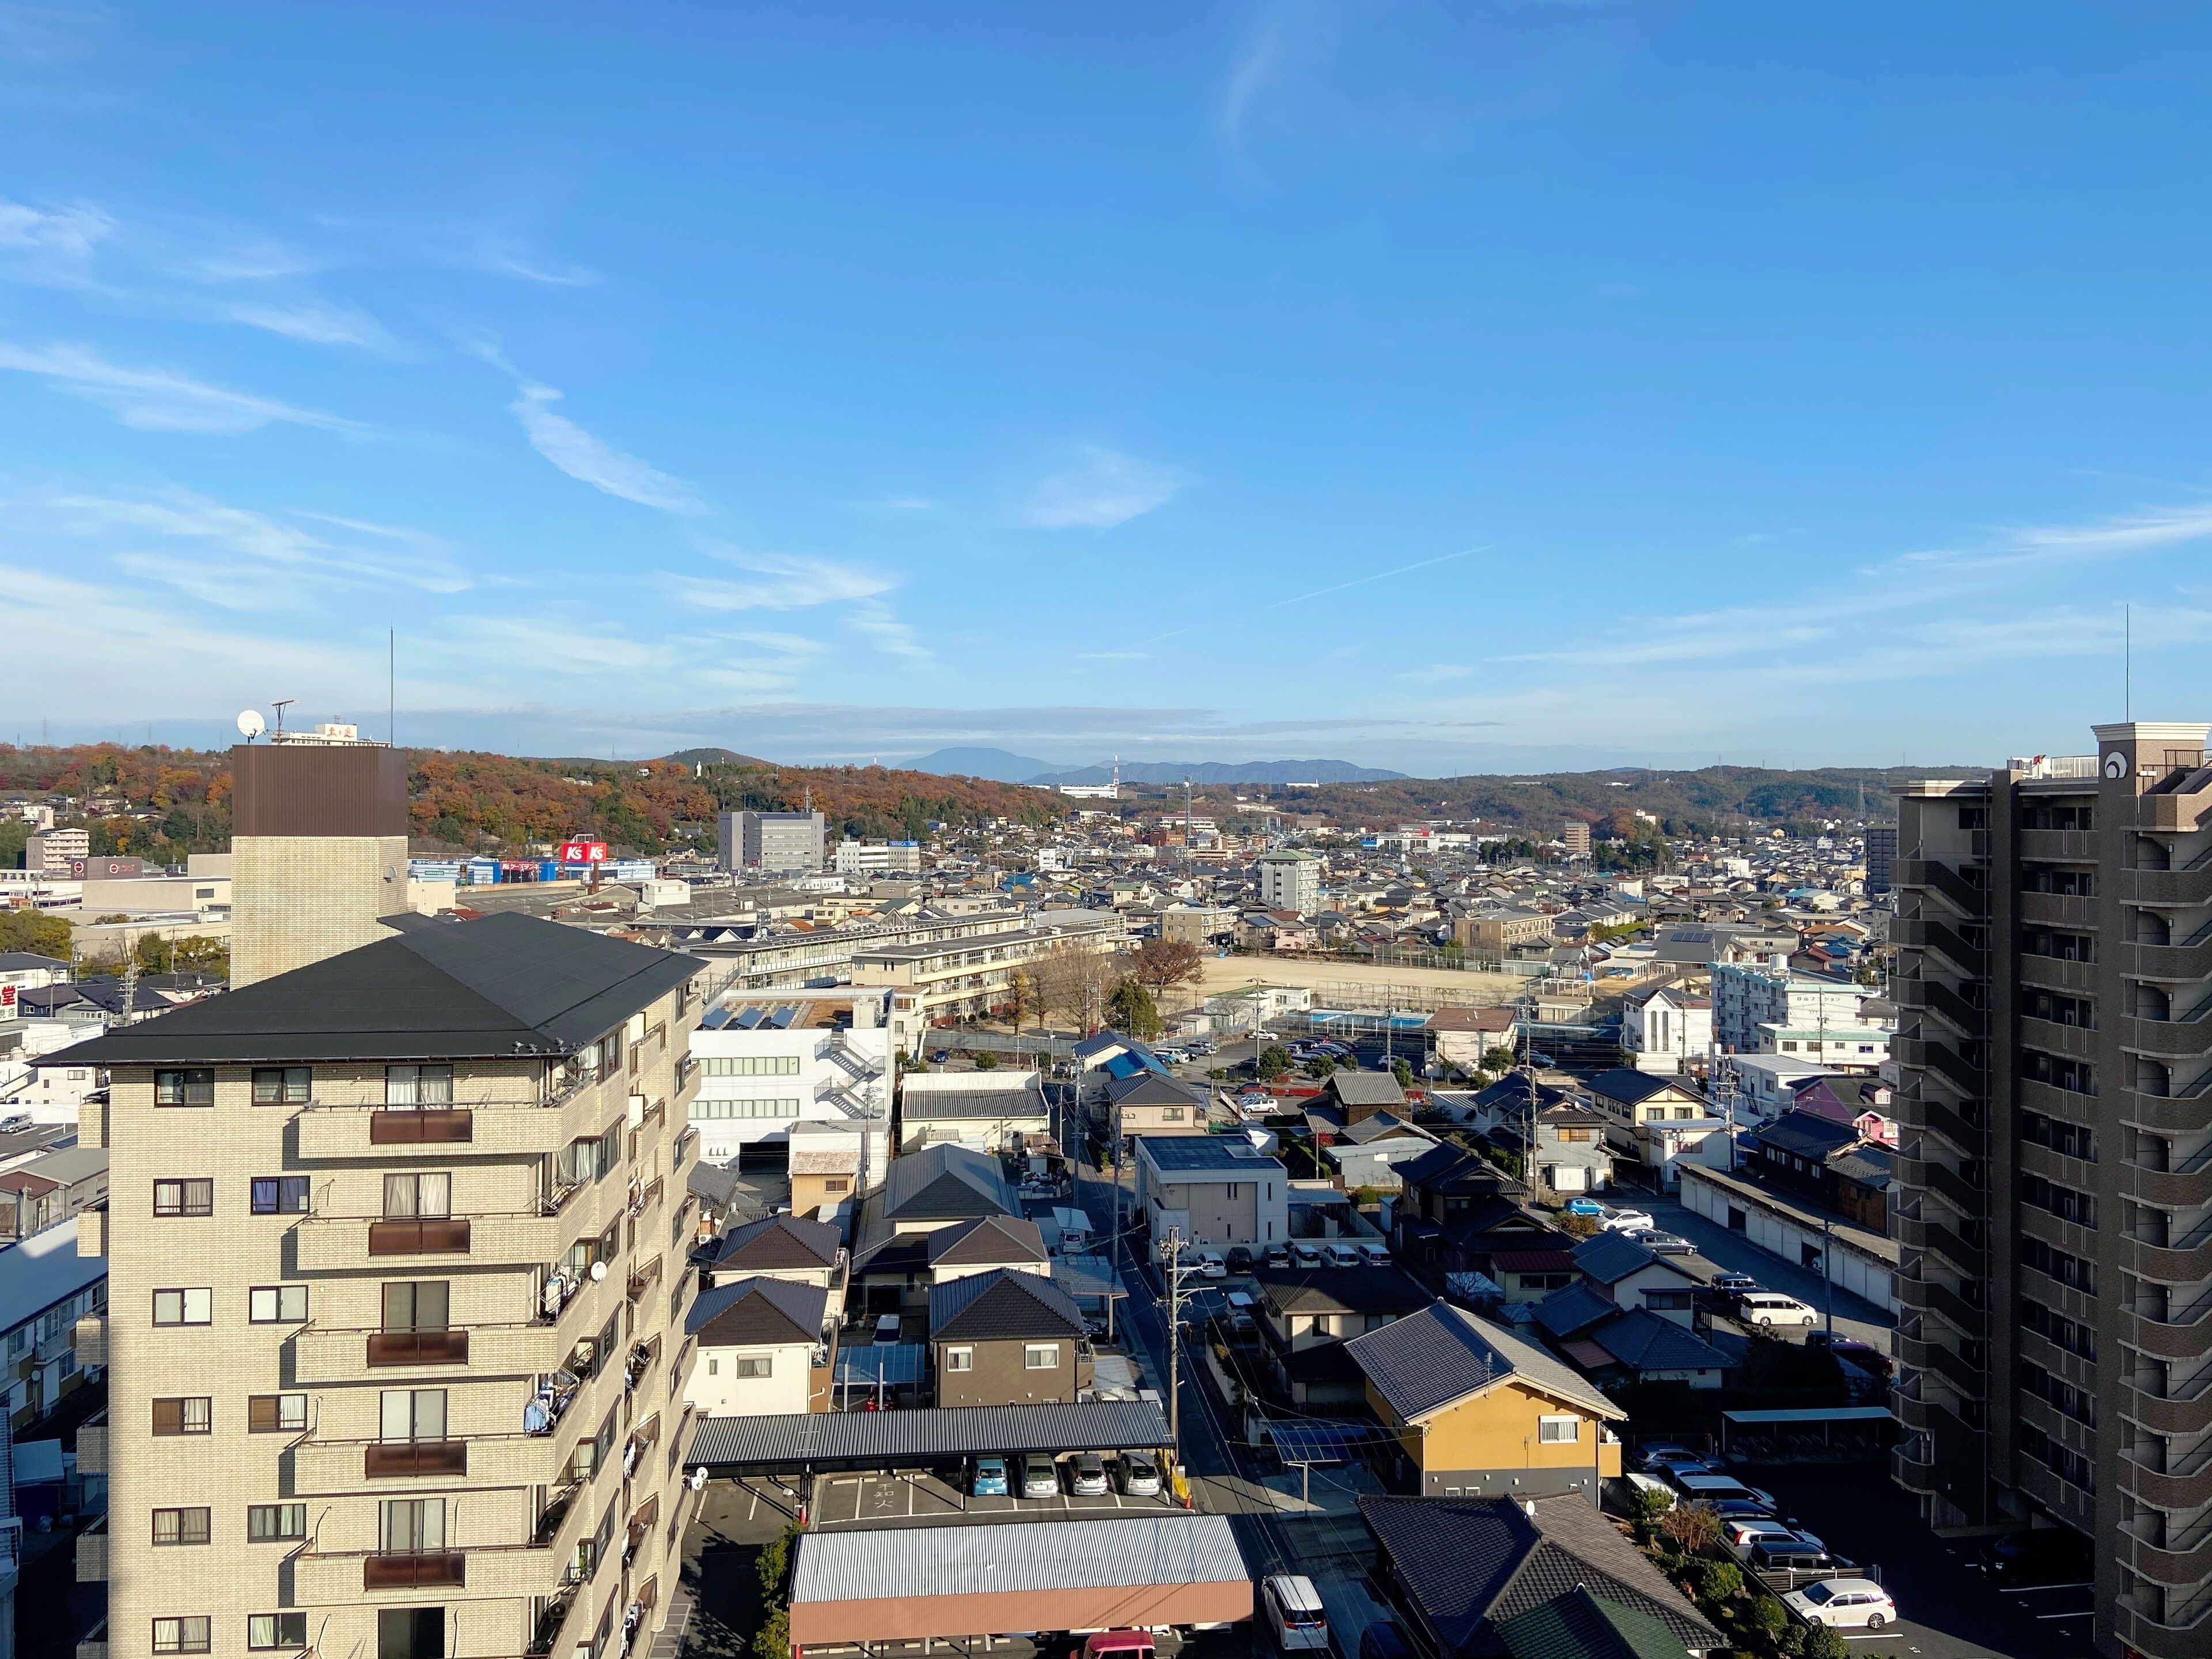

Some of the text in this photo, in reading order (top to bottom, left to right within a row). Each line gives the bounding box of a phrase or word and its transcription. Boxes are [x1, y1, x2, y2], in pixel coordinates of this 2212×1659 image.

[0, 985, 16, 1006] 堂
[873, 1483, 894, 1508] 不知火
